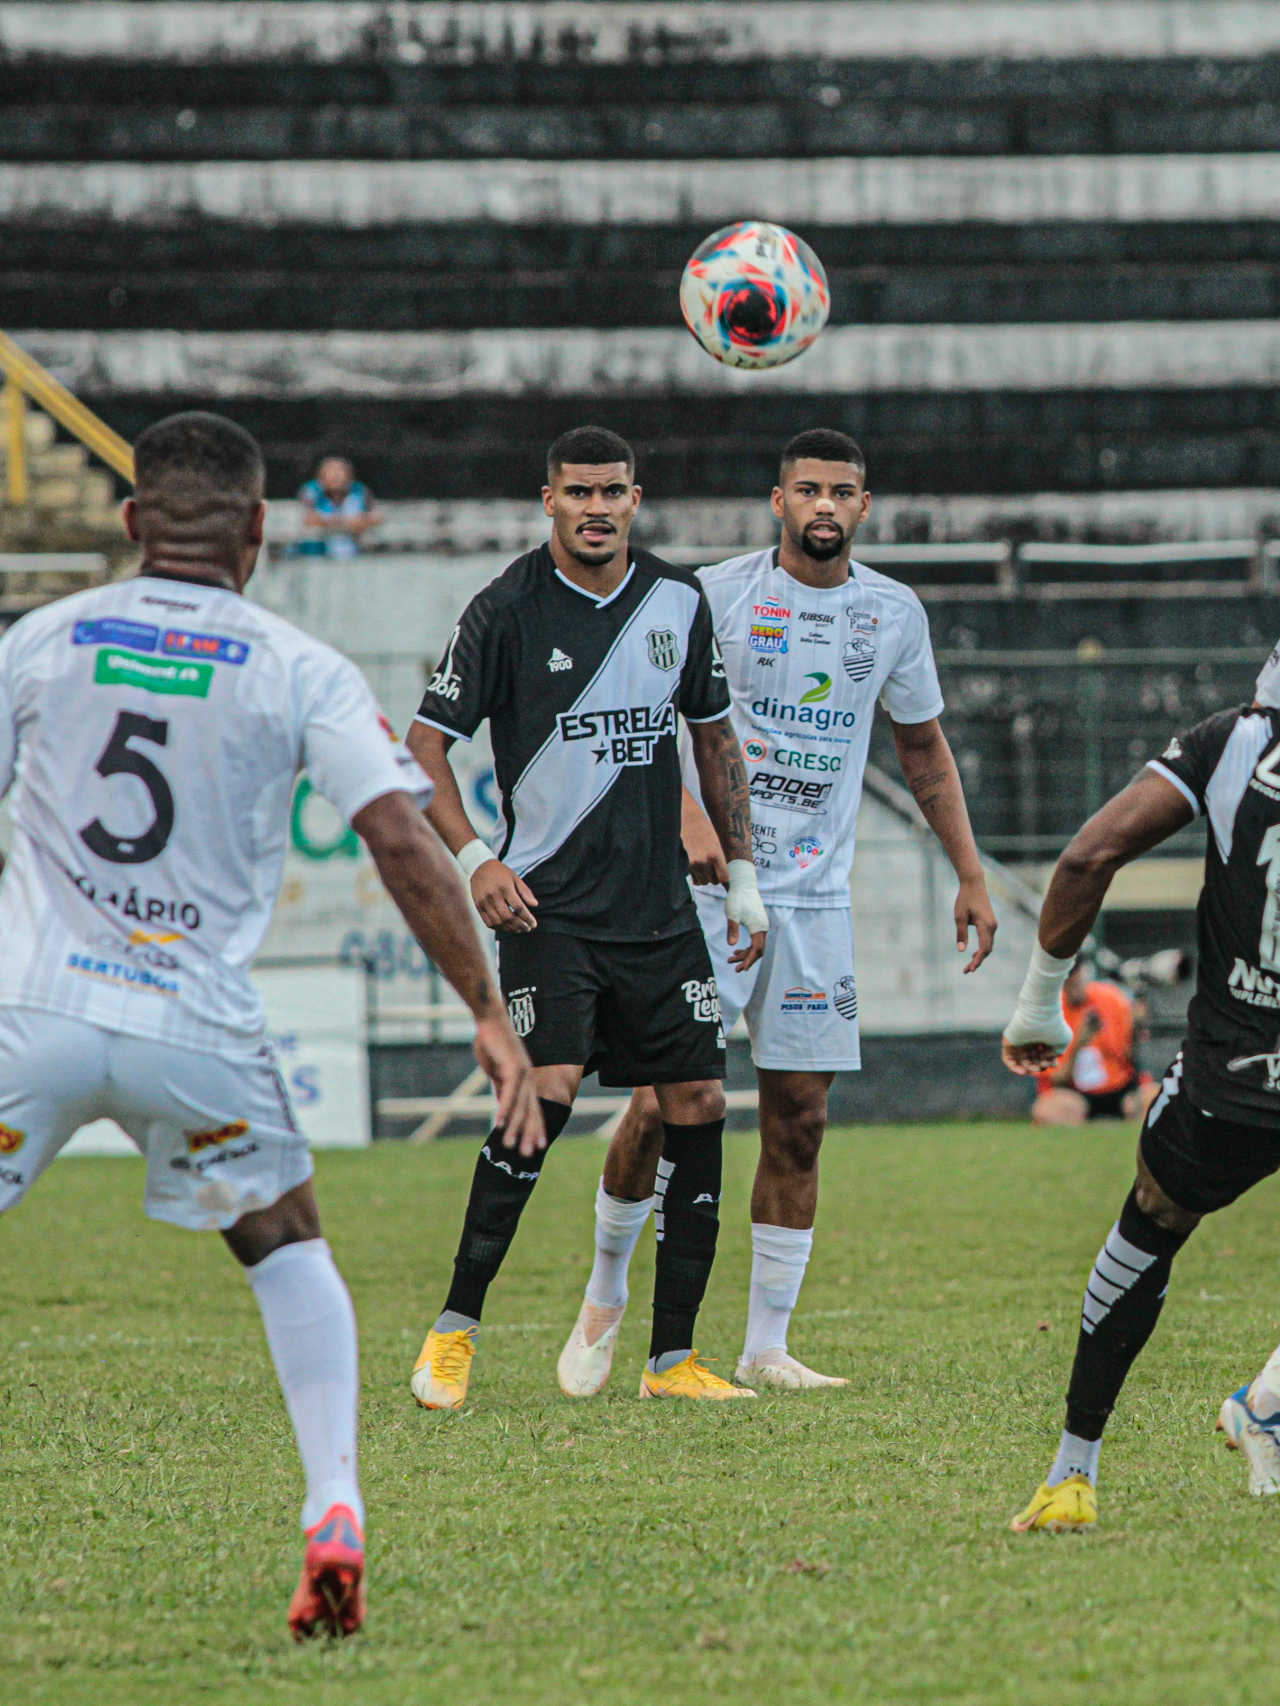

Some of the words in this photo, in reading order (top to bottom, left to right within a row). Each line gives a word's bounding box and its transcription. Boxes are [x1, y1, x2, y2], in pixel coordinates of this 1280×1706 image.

[753, 605, 791, 618] TONIN
[751, 625, 784, 638] ZERO
[750, 635, 783, 649] GRAU
[550, 659, 574, 672] 1900
[752, 697, 856, 731] dinagro
[559, 704, 677, 742] ESTRELA
[611, 736, 656, 765] BET
[78, 708, 175, 865] 5
[751, 822, 777, 839] RENTE
